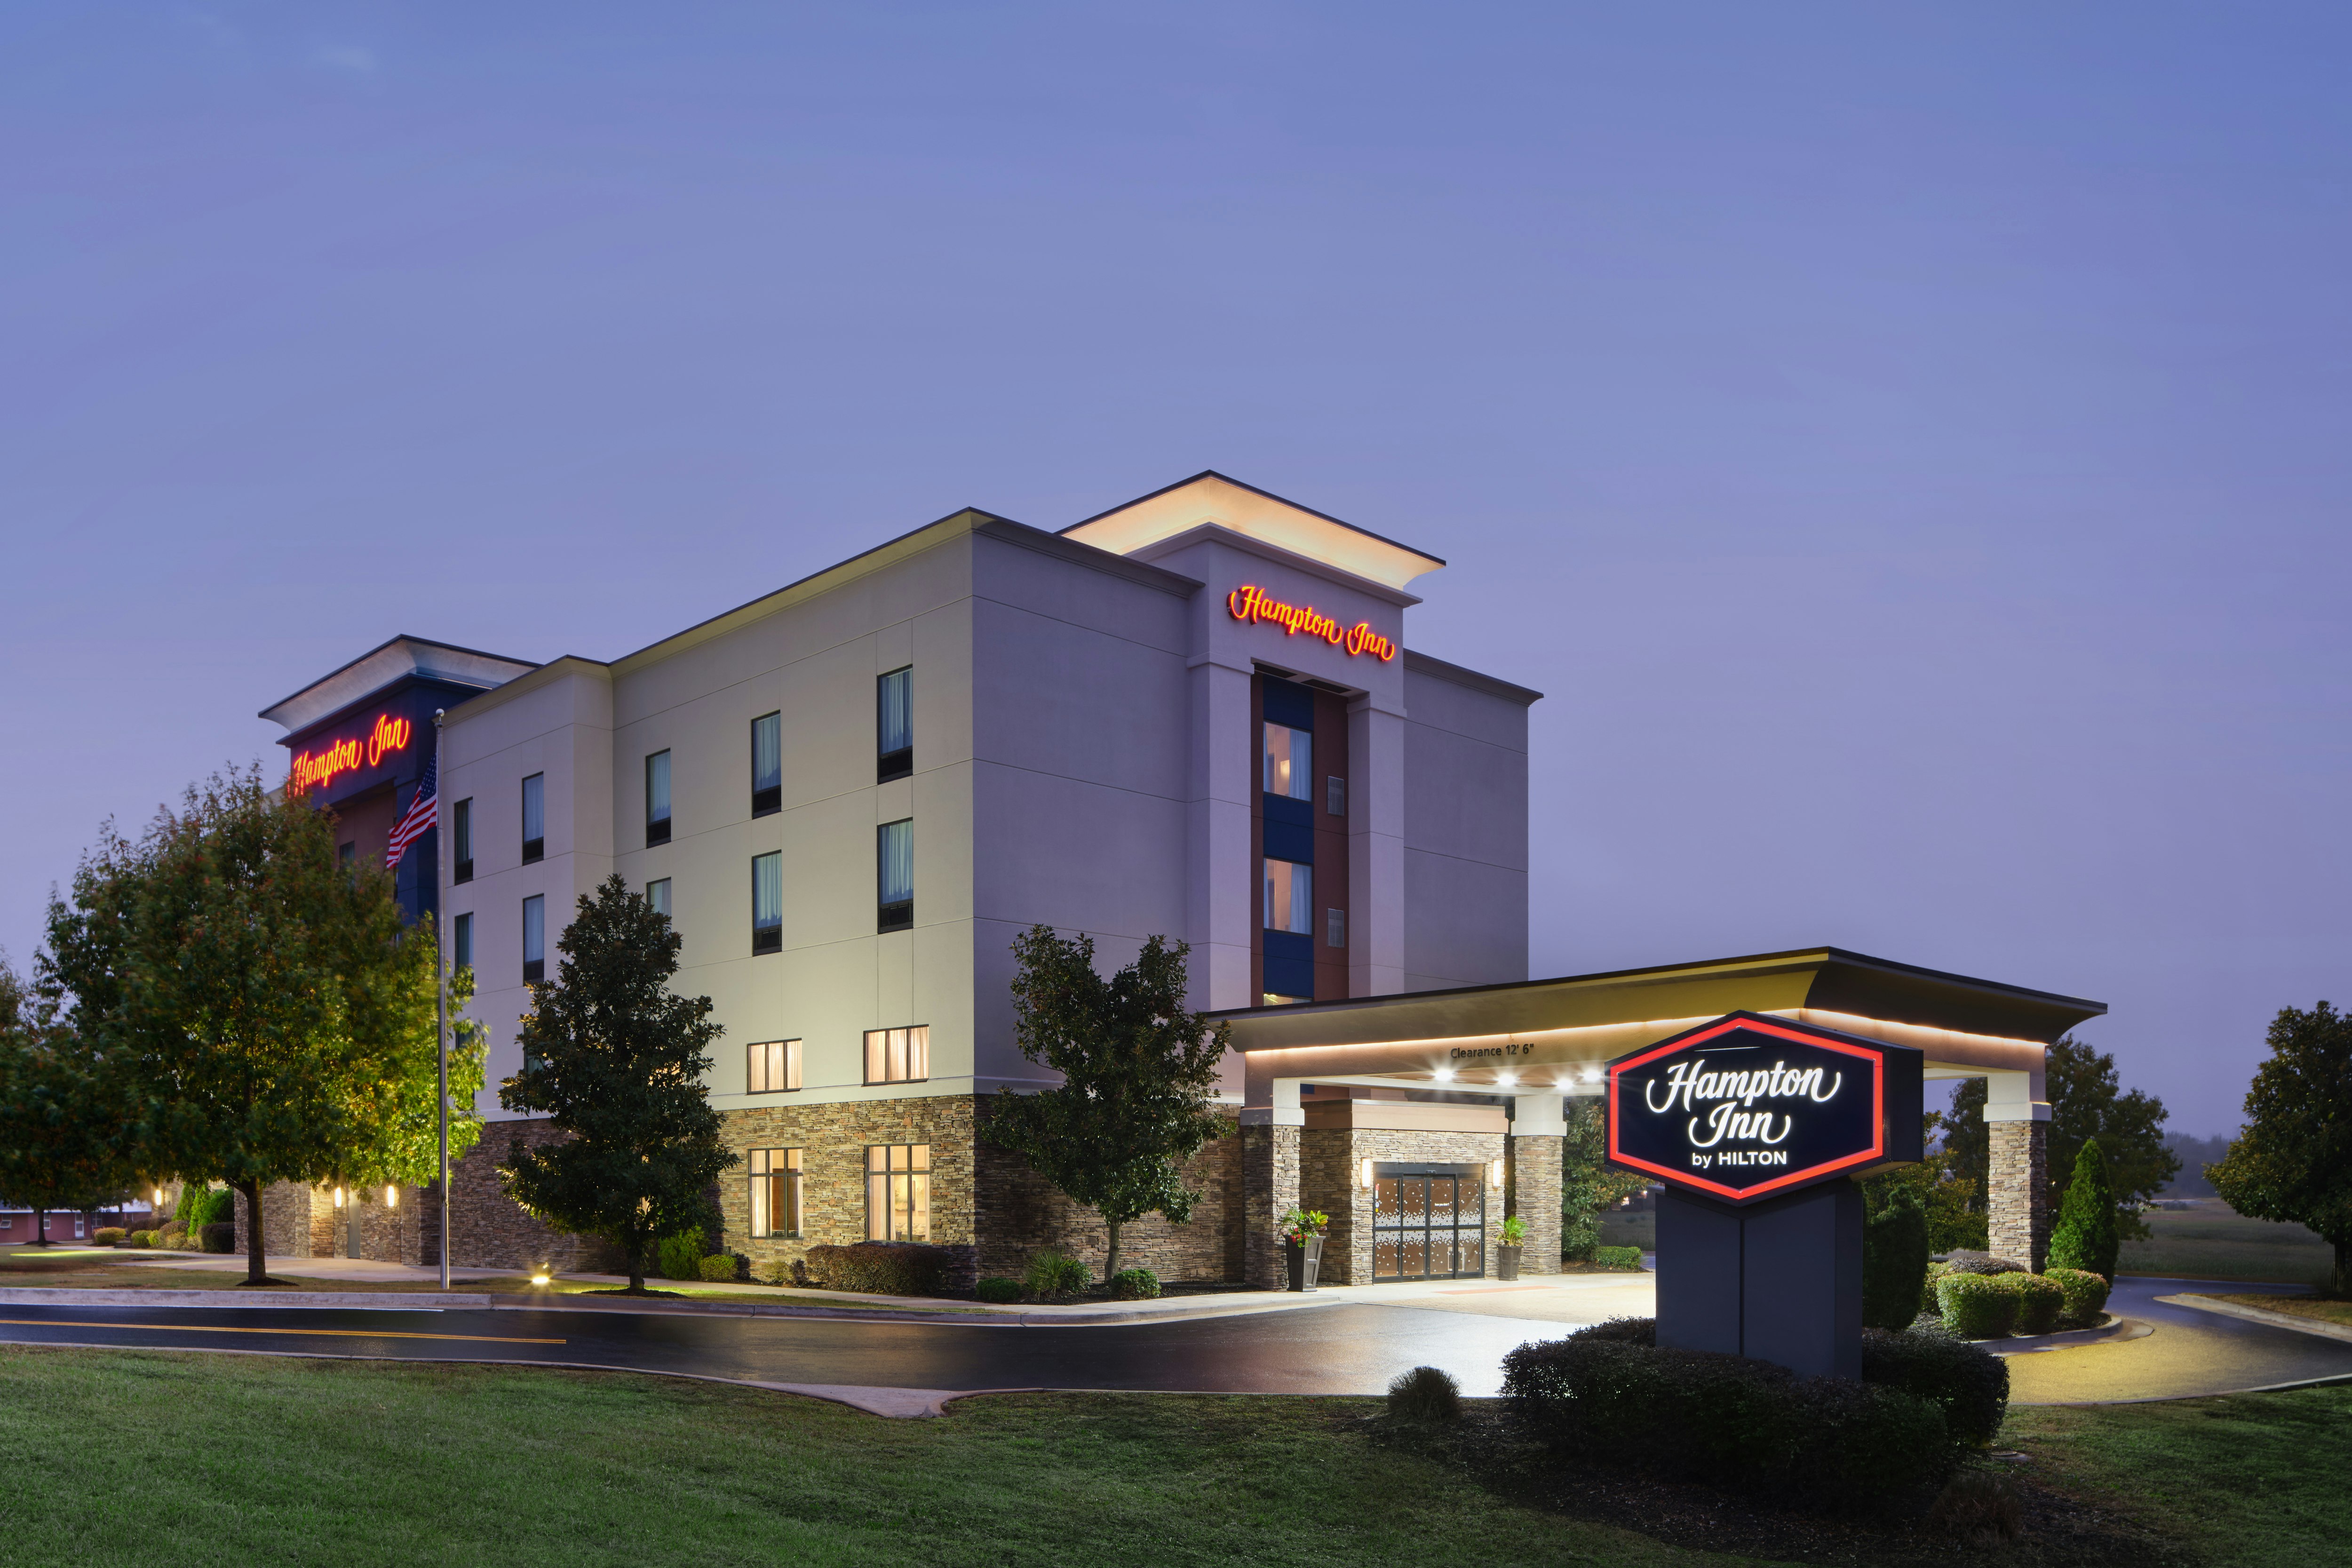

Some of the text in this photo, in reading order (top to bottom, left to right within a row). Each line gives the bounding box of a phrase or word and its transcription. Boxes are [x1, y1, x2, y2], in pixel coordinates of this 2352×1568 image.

[1229, 585, 1395, 661] Hampton Inn
[287, 714, 409, 798] Hampton Inn
[1450, 1043, 1534, 1059] Clearance 12' 6"
[1645, 1059, 1841, 1114] Hampton
[1688, 1101, 1792, 1147] Inn
[1692, 1151, 1787, 1169] by HILTON
